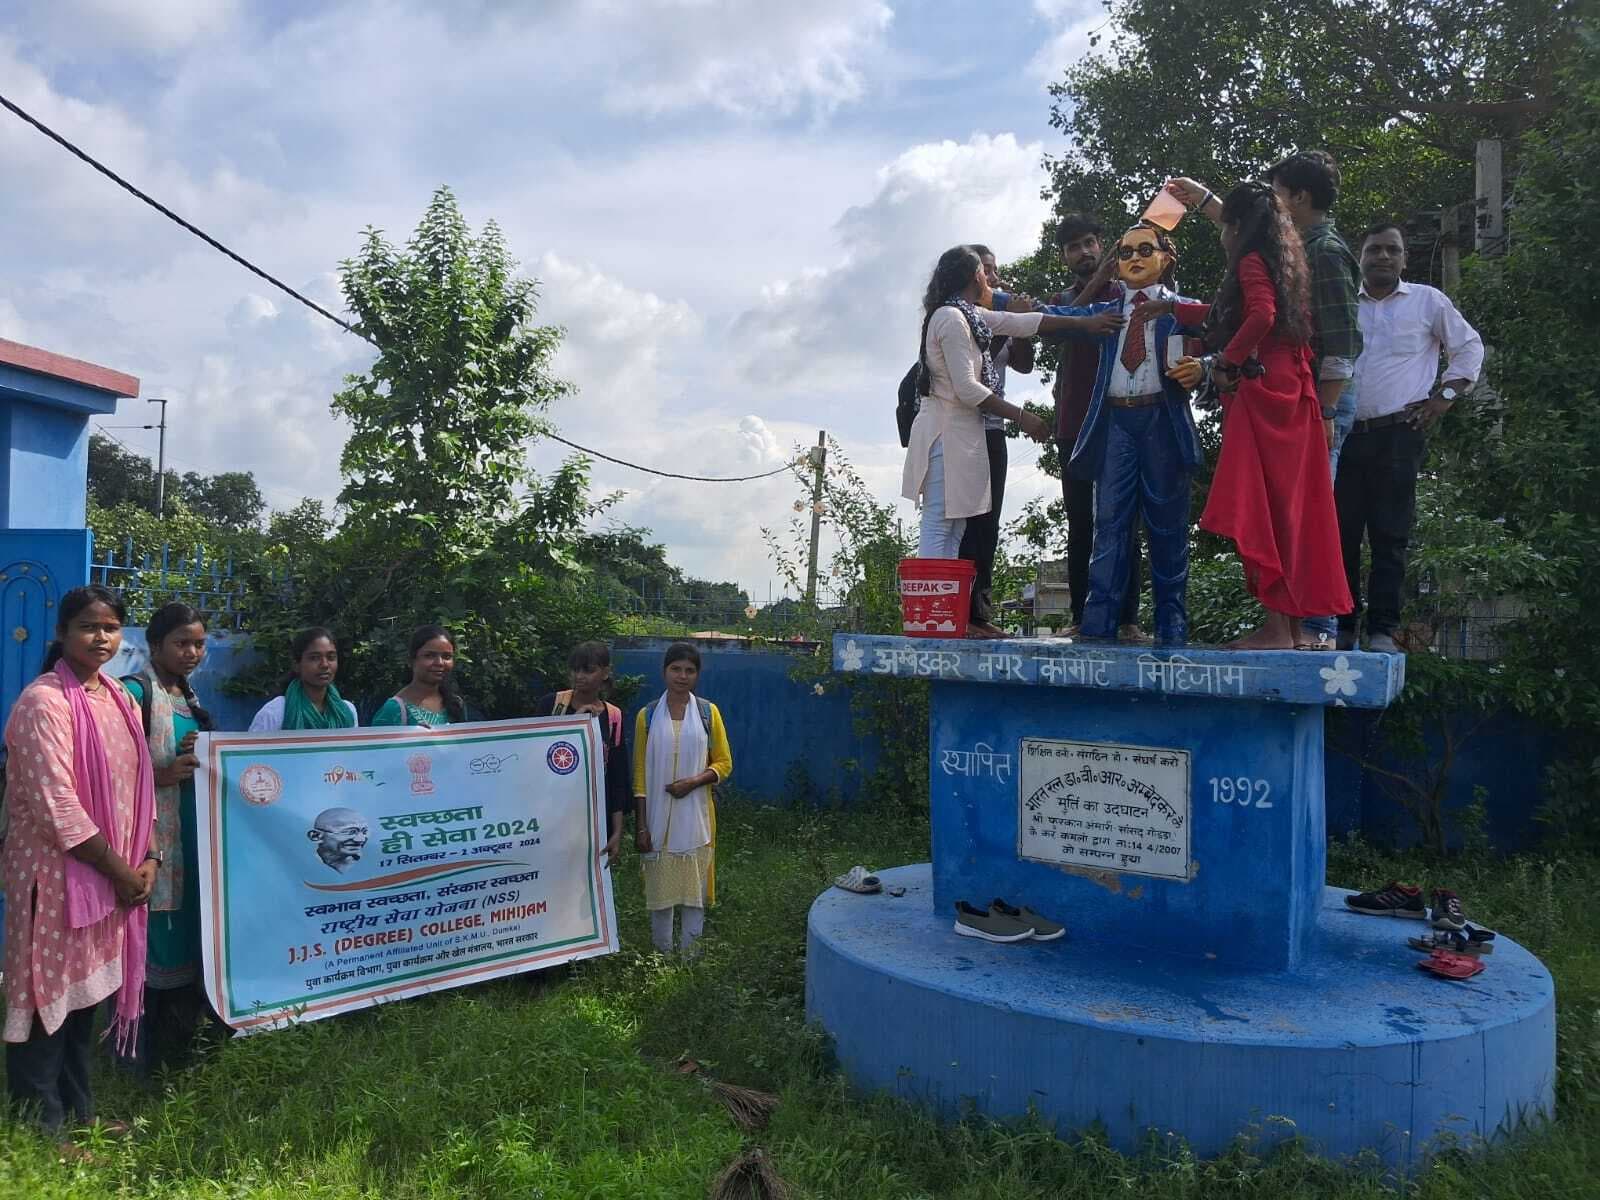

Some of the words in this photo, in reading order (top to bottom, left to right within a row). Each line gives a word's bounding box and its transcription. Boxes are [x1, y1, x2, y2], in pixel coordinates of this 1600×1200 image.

[902, 583, 939, 592] DEEPAK
[978, 653, 1028, 681] नगर
[940, 742, 1011, 784] स्थापित
[1083, 800, 1099, 813] का
[1209, 777, 1273, 808] 1992
[378, 805, 483, 830] स्वच्छता
[379, 831, 413, 854] ही
[421, 827, 477, 847] सेवा
[482, 818, 540, 839] 2024
[520, 838, 541, 847] 2024
[304, 900, 362, 917] स्वभाव
[437, 883, 489, 897] संस्कार
[490, 871, 539, 888] स्वच्छता
[320, 914, 381, 934] राष्ट्रीय
[384, 909, 421, 924] सेवा
[424, 898, 479, 917] योजना
[481, 890, 520, 909] (NSS)
[288, 943, 327, 964] J.J.S.
[334, 928, 413, 955] (DEGREE)
[490, 901, 547, 923] MIHIJAM
[515, 932, 538, 943] सरकार
[325, 961, 335, 970] (A
[337, 951, 384, 966] Permanent
[385, 944, 423, 957] Affiliated
[426, 940, 444, 949] Unit
[445, 938, 453, 946] of
